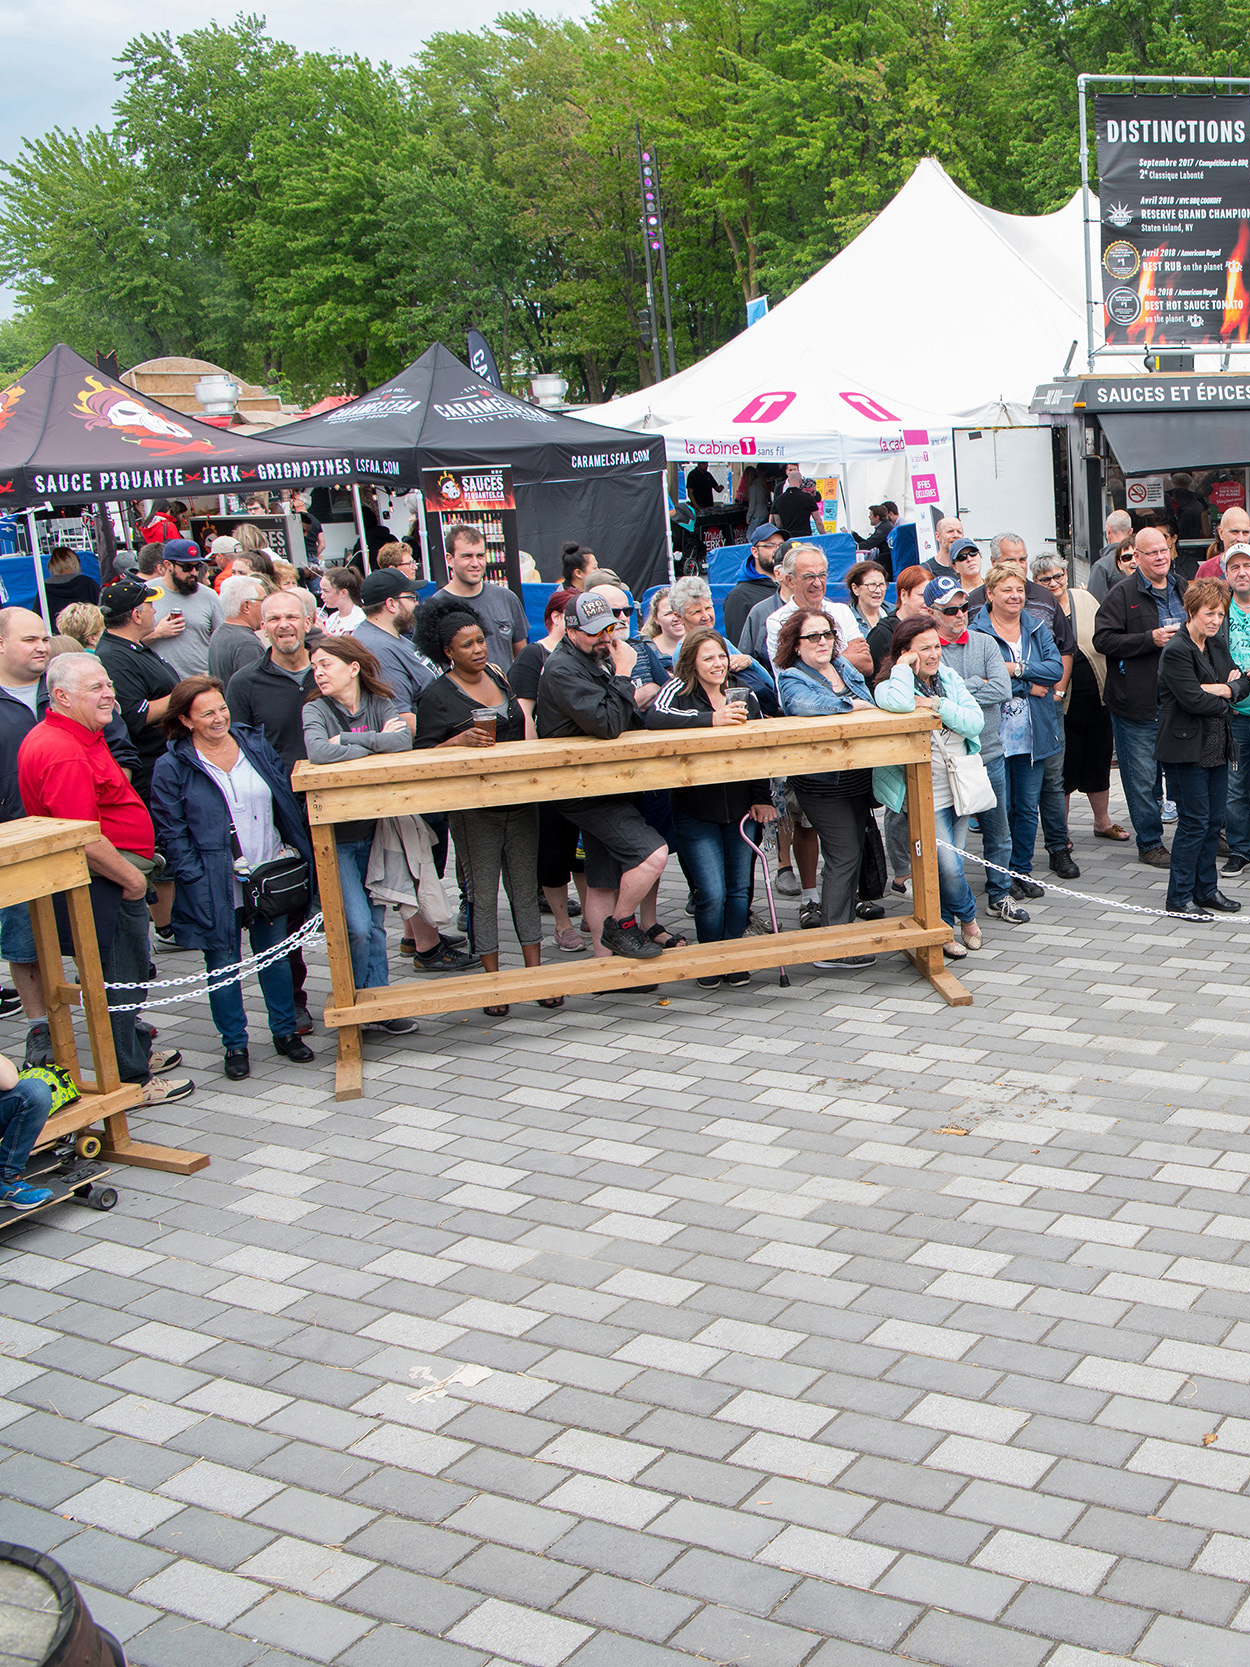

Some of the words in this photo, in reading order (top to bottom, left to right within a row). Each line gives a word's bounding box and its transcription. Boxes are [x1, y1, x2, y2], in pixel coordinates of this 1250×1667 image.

[1106, 120, 1246, 143] DISTINCTIONS
[1138, 158, 1177, 168] Septembre
[1179, 158, 1195, 167] 2017
[1230, 159, 1238, 167] de
[1237, 159, 1249, 168] BBQ
[1149, 171, 1178, 181] Classique
[1179, 170, 1204, 180] Labonté
[1140, 196, 1158, 205] Avril
[1158, 196, 1175, 205] 2018
[1189, 197, 1201, 206] BBQ
[1141, 209, 1176, 219] RESERVE
[1178, 209, 1207, 219] GRAND
[1141, 223, 1161, 232] Staten
[1162, 223, 1184, 233] Island,
[1185, 223, 1194, 232] NY
[1142, 249, 1159, 257] Avril
[1160, 249, 1176, 257] 2018
[1206, 249, 1221, 257] Royal
[1143, 261, 1163, 272] BEST
[1164, 261, 1181, 272] RUB
[1192, 262, 1202, 271] the
[1203, 262, 1223, 273] planet
[1144, 288, 1156, 296] Mai
[1157, 288, 1173, 296] 2018
[1203, 288, 1218, 297] Royal
[1144, 300, 1165, 310] BEST
[1165, 300, 1182, 310] HOT
[1183, 300, 1210, 310] SAUCE
[1212, 299, 1244, 310] TOMATO
[1153, 314, 1164, 323] the
[1165, 314, 1185, 324] planet
[1097, 386, 1166, 403] SAUCES
[1170, 386, 1192, 402] ET
[685, 439, 696, 454] la
[698, 439, 740, 455] cabine
[757, 447, 774, 456] sans
[776, 445, 785, 456] fil
[880, 436, 889, 452] la
[571, 449, 651, 469] CARAMELSFAA.COM
[34, 473, 93, 494] SAUCE
[100, 468, 184, 491] PIQUANTE
[202, 465, 242, 484] JERK
[257, 458, 351, 480] GRIGNOTINES
[461, 476, 504, 492] SAUCES
[464, 491, 504, 500] PIQUANTES.CA
